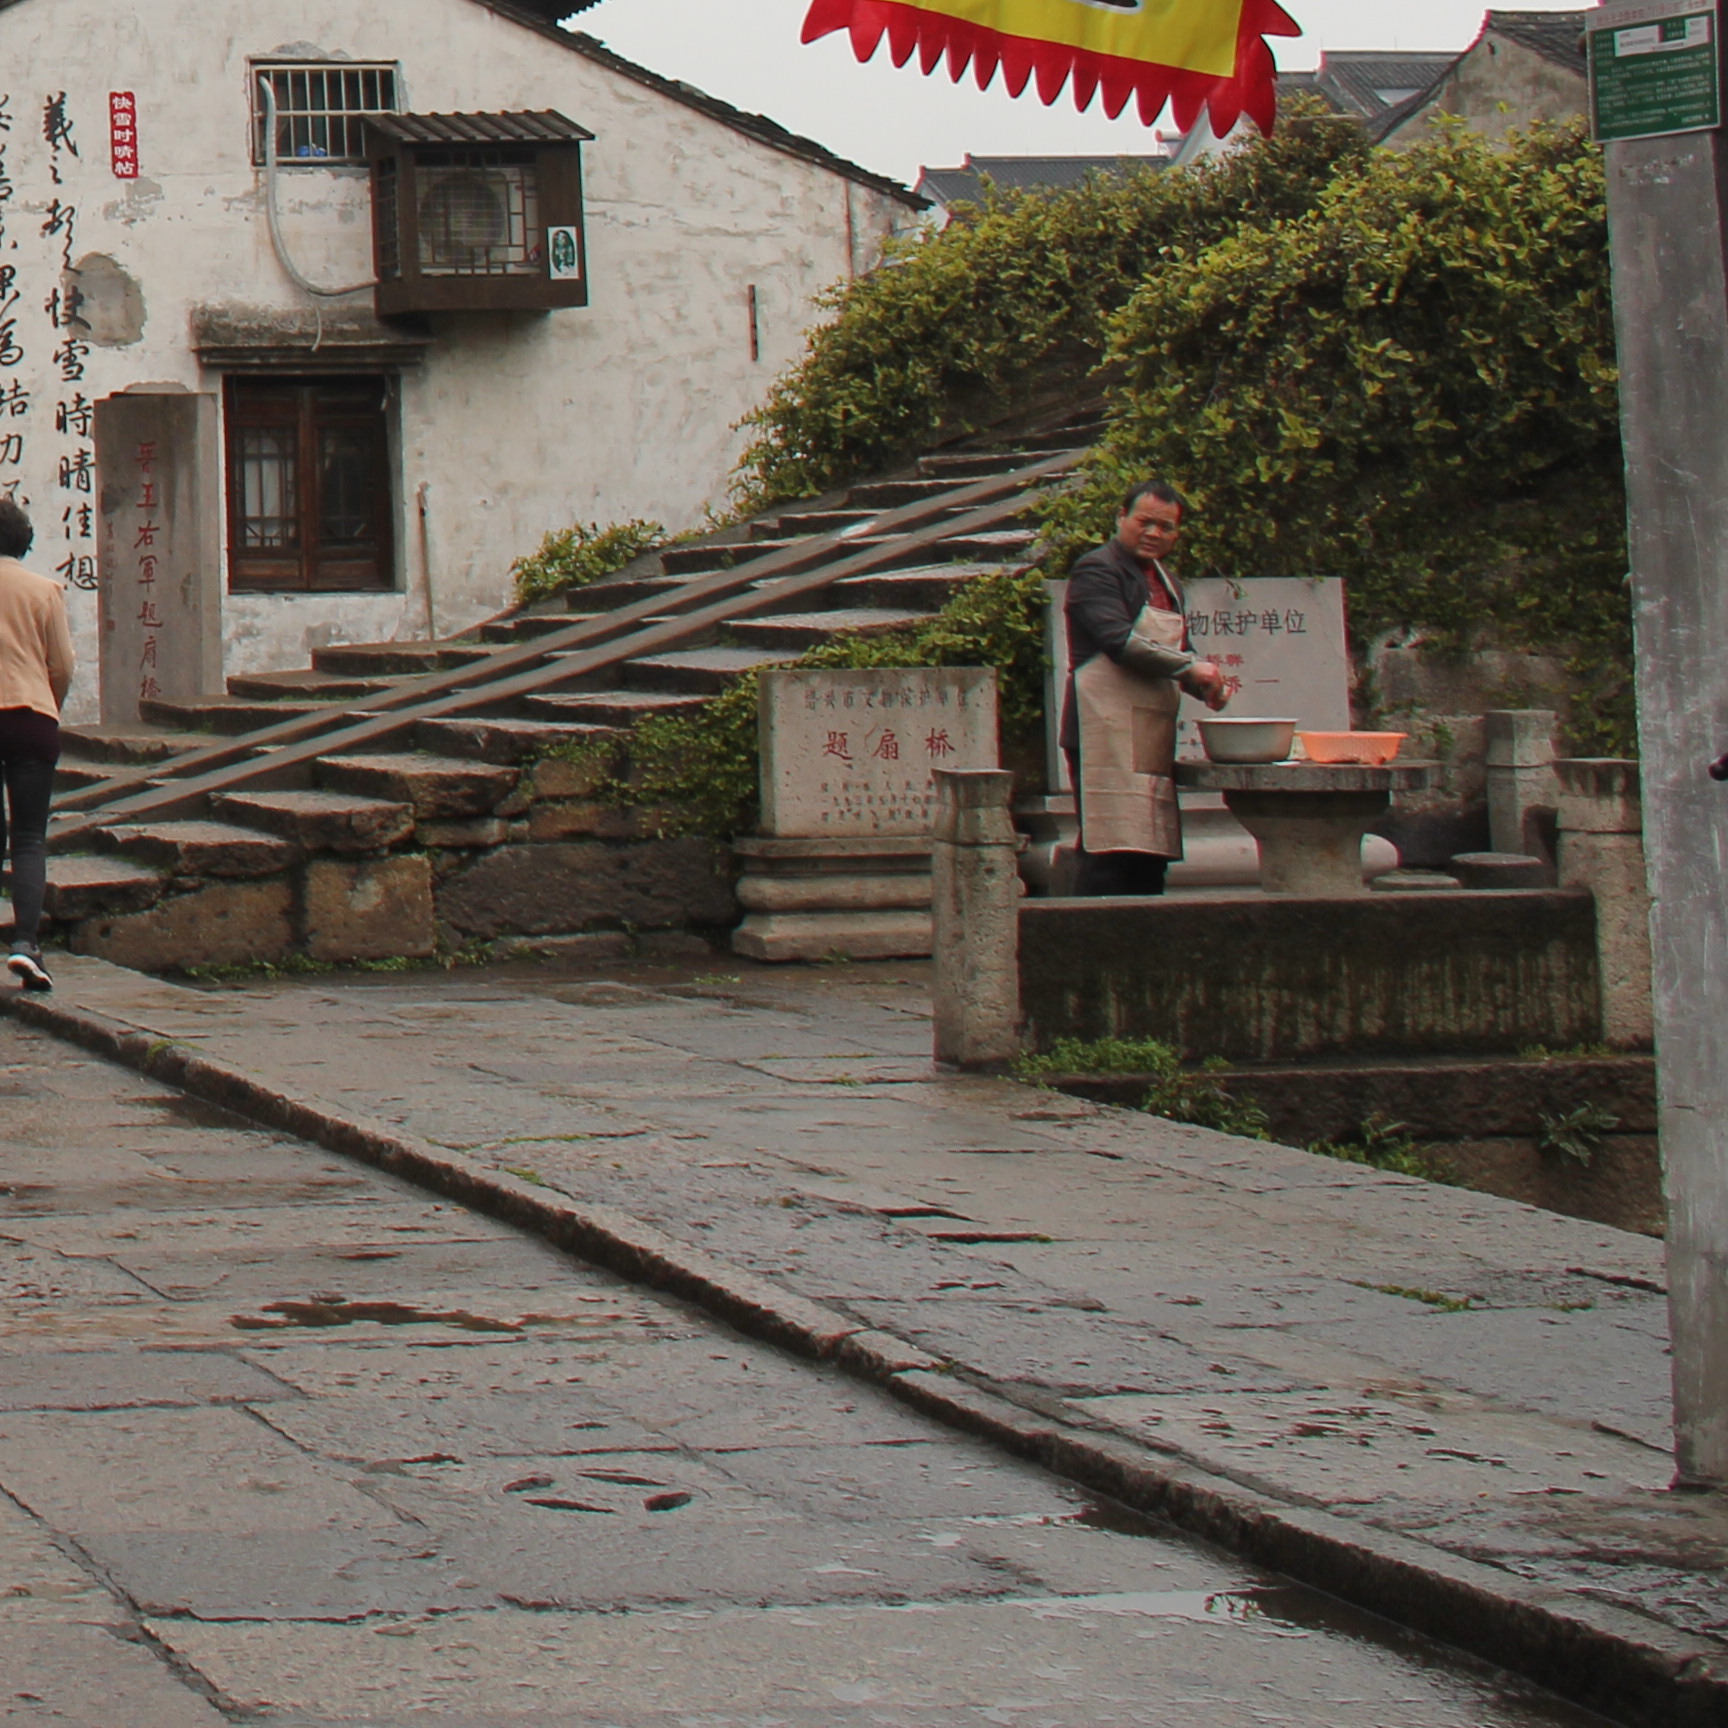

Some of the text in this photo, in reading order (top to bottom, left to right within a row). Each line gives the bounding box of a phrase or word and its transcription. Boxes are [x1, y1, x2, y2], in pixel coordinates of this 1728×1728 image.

[1187, 608, 1307, 636] 物保护单位
[822, 727, 956, 761] 题扇桥
